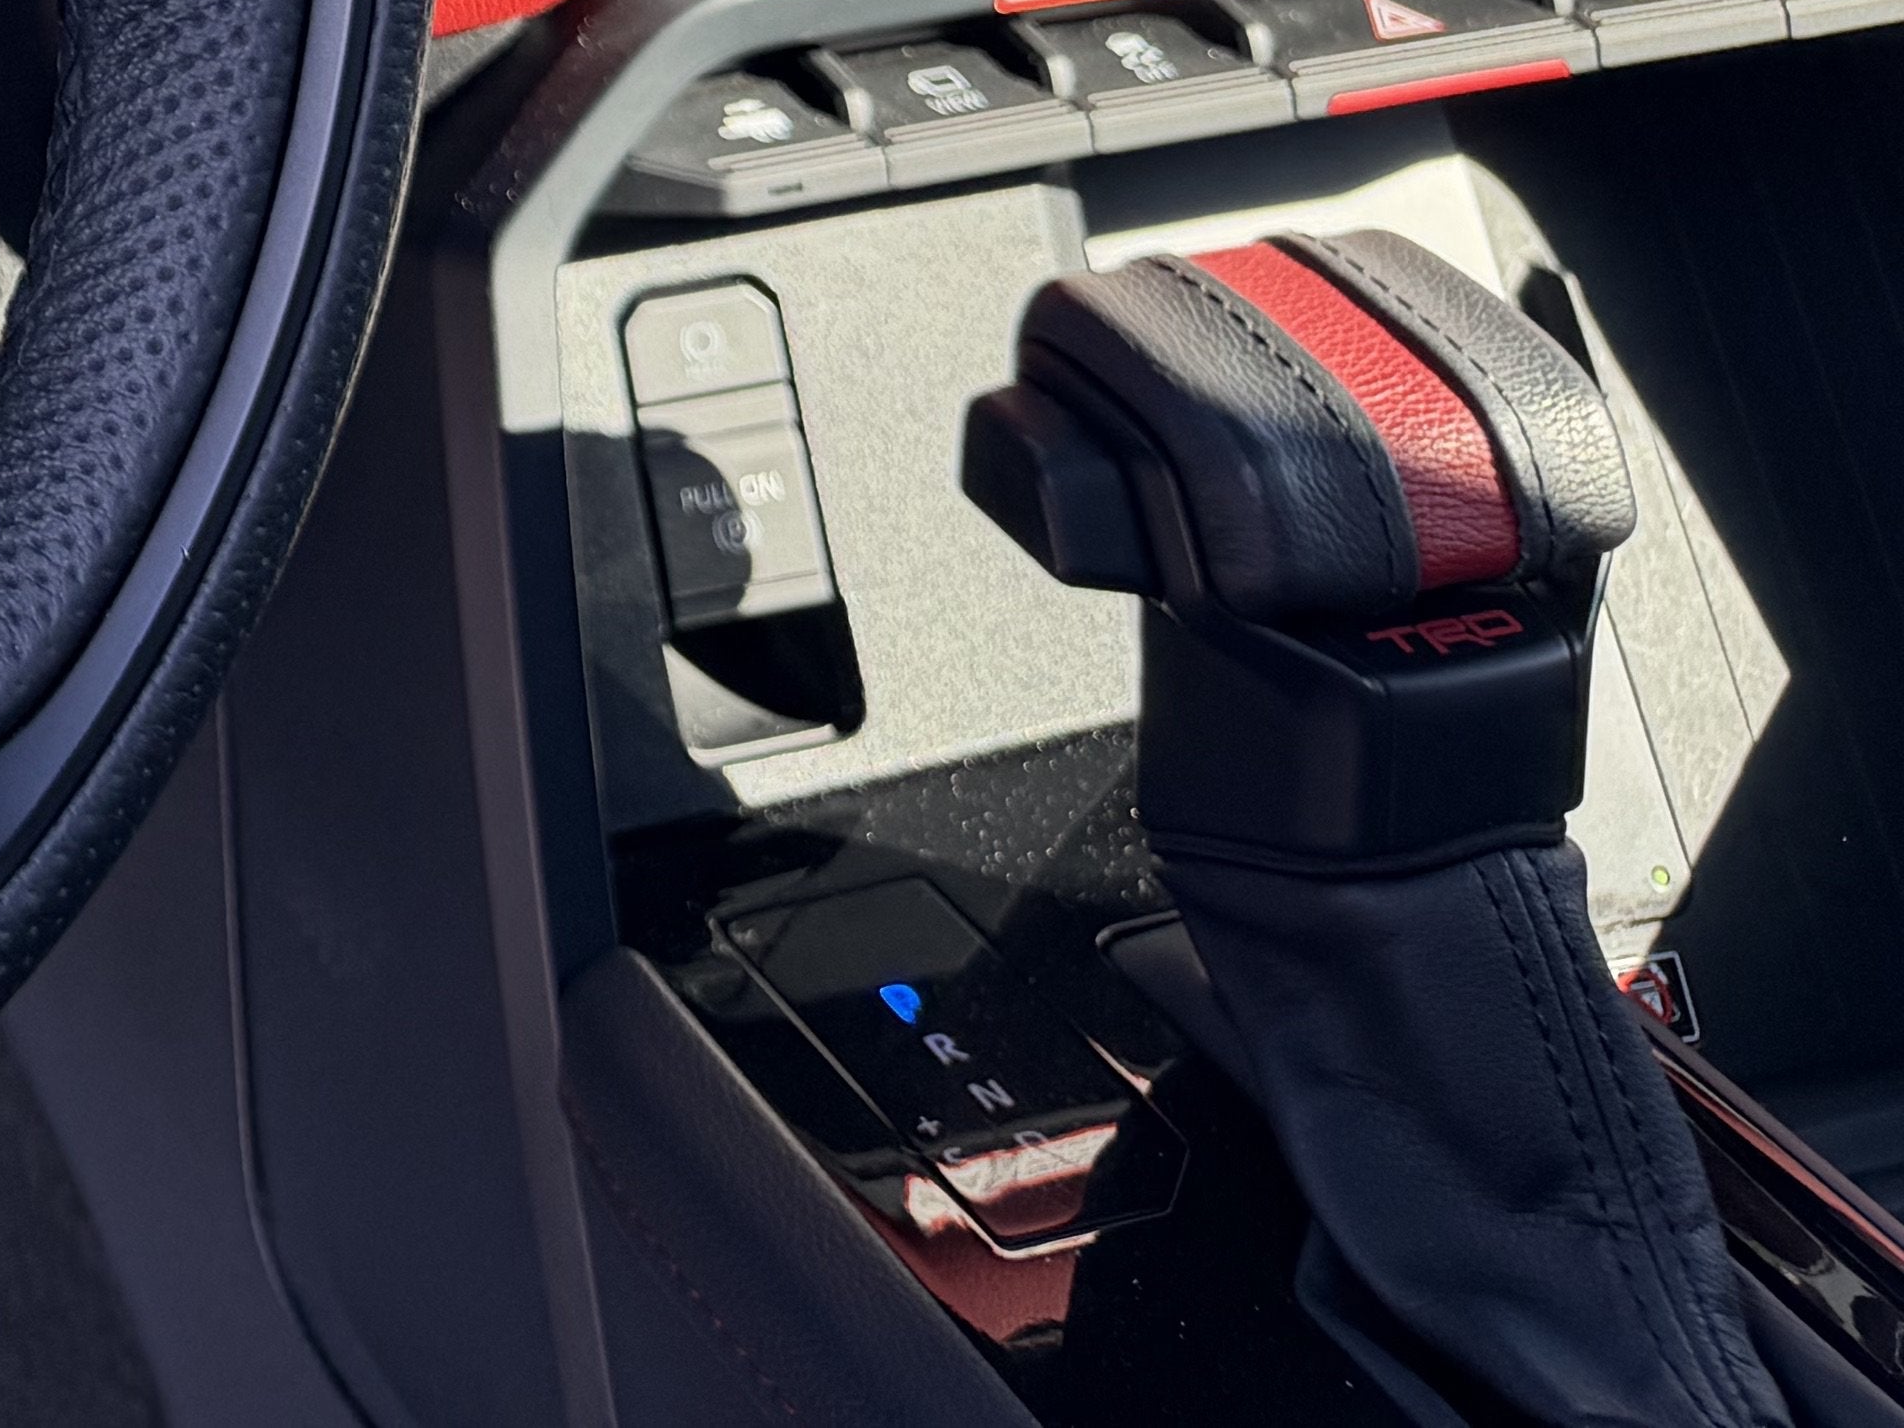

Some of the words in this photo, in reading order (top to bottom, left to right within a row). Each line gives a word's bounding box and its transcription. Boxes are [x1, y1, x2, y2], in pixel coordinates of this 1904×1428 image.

[680, 479, 734, 516] PULL
[739, 469, 787, 506] ON
[1366, 608, 1524, 657] TRD
[922, 1032, 972, 1066] R
[967, 1078, 1017, 1113] N
